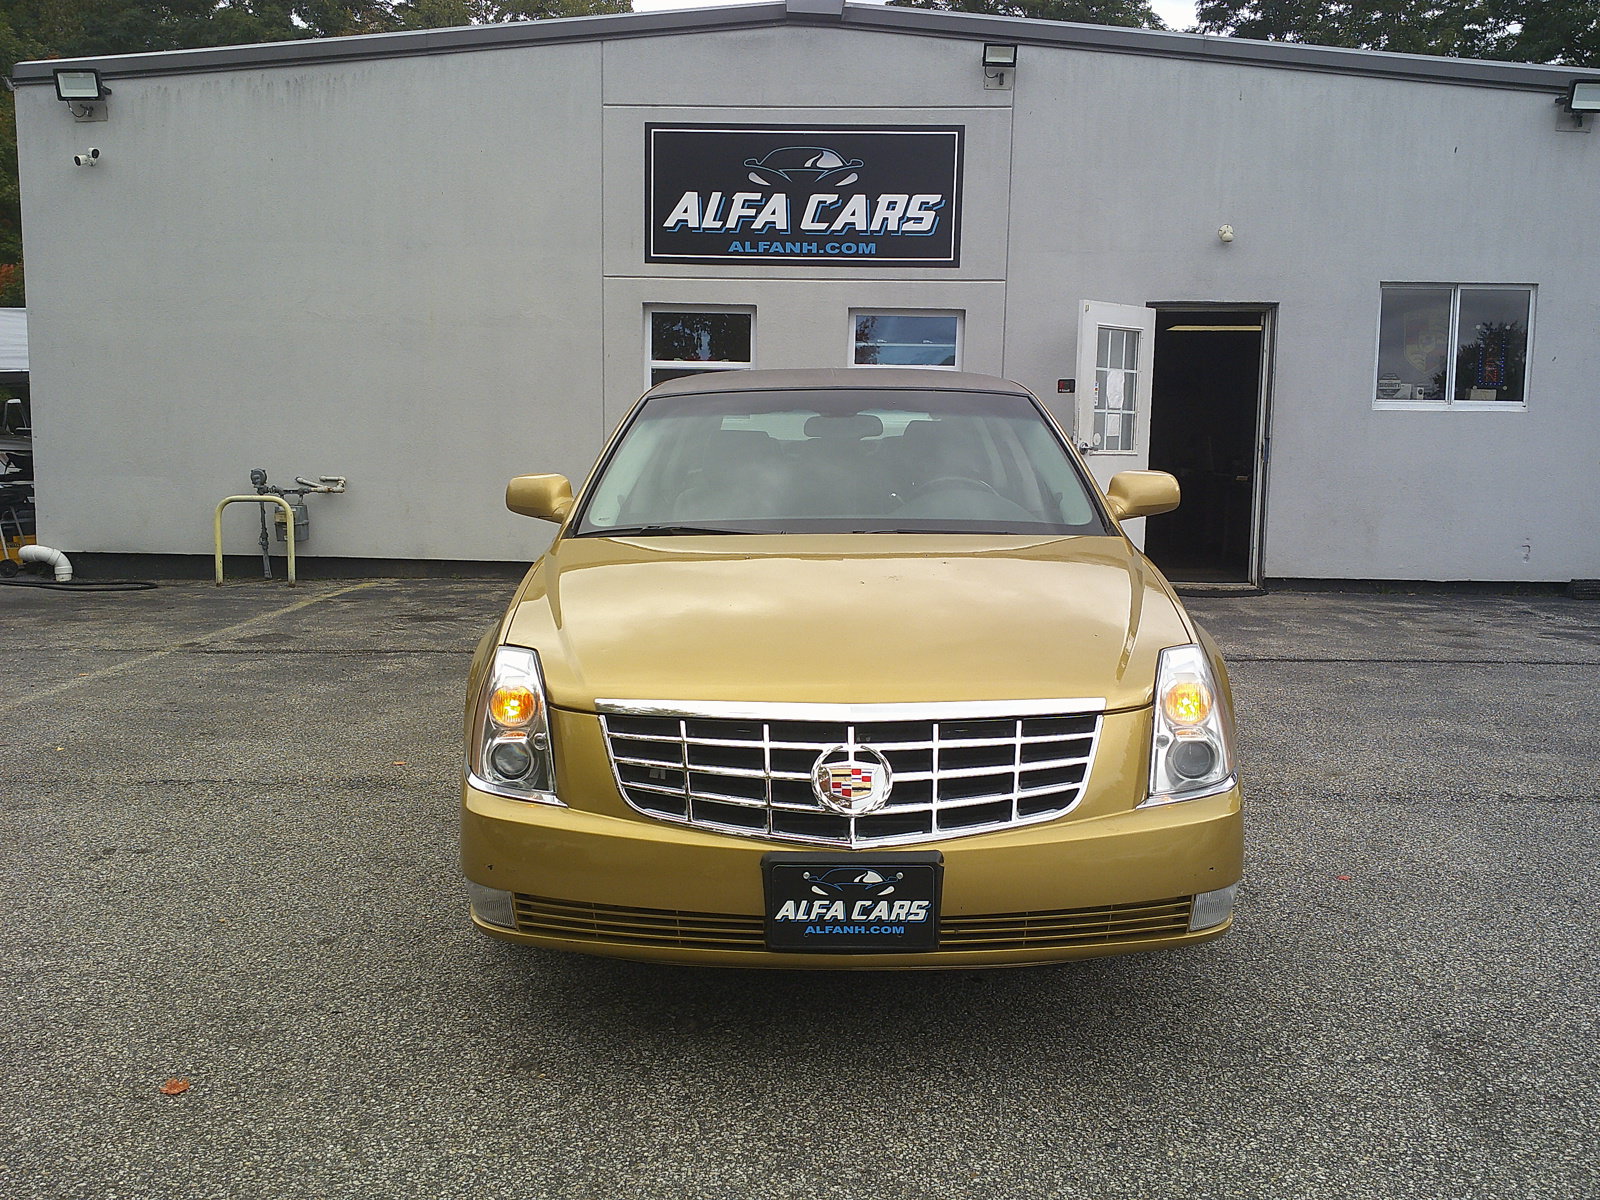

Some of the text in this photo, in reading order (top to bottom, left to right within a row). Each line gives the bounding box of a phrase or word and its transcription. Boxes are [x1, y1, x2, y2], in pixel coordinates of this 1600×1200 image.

[663, 191, 945, 236] ALFA CARS
[728, 241, 876, 254] ALFANH.COM
[775, 900, 931, 923] ALFA CARS
[805, 926, 905, 934] ALFANH.COM
